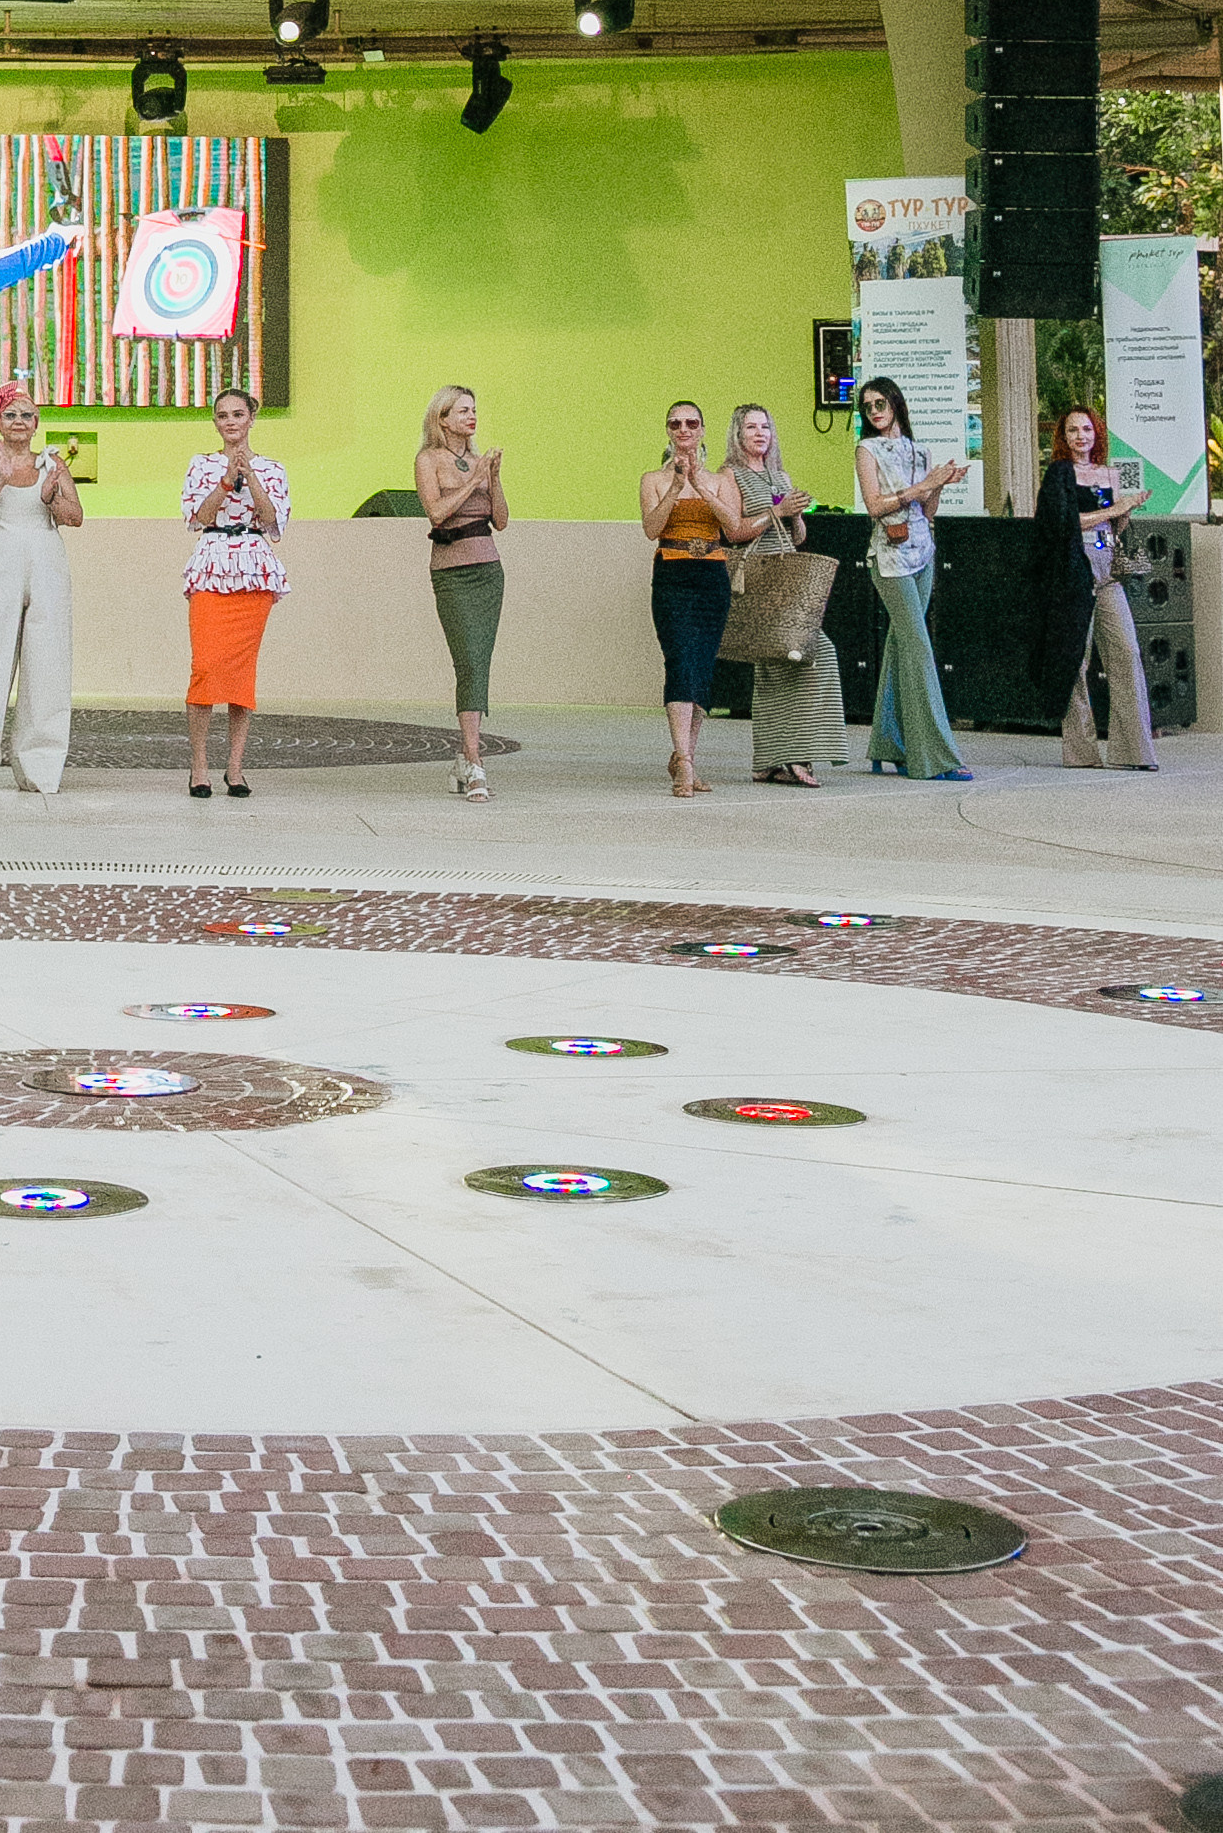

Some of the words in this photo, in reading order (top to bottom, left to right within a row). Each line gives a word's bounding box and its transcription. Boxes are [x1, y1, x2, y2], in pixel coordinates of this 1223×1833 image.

[908, 220, 951, 231] ПХУКЕТ
[1134, 377, 1165, 387] Продажа
[1135, 389, 1163, 399] Покупка
[1135, 402, 1160, 411] Аренда
[1135, 414, 1175, 423] Управление
